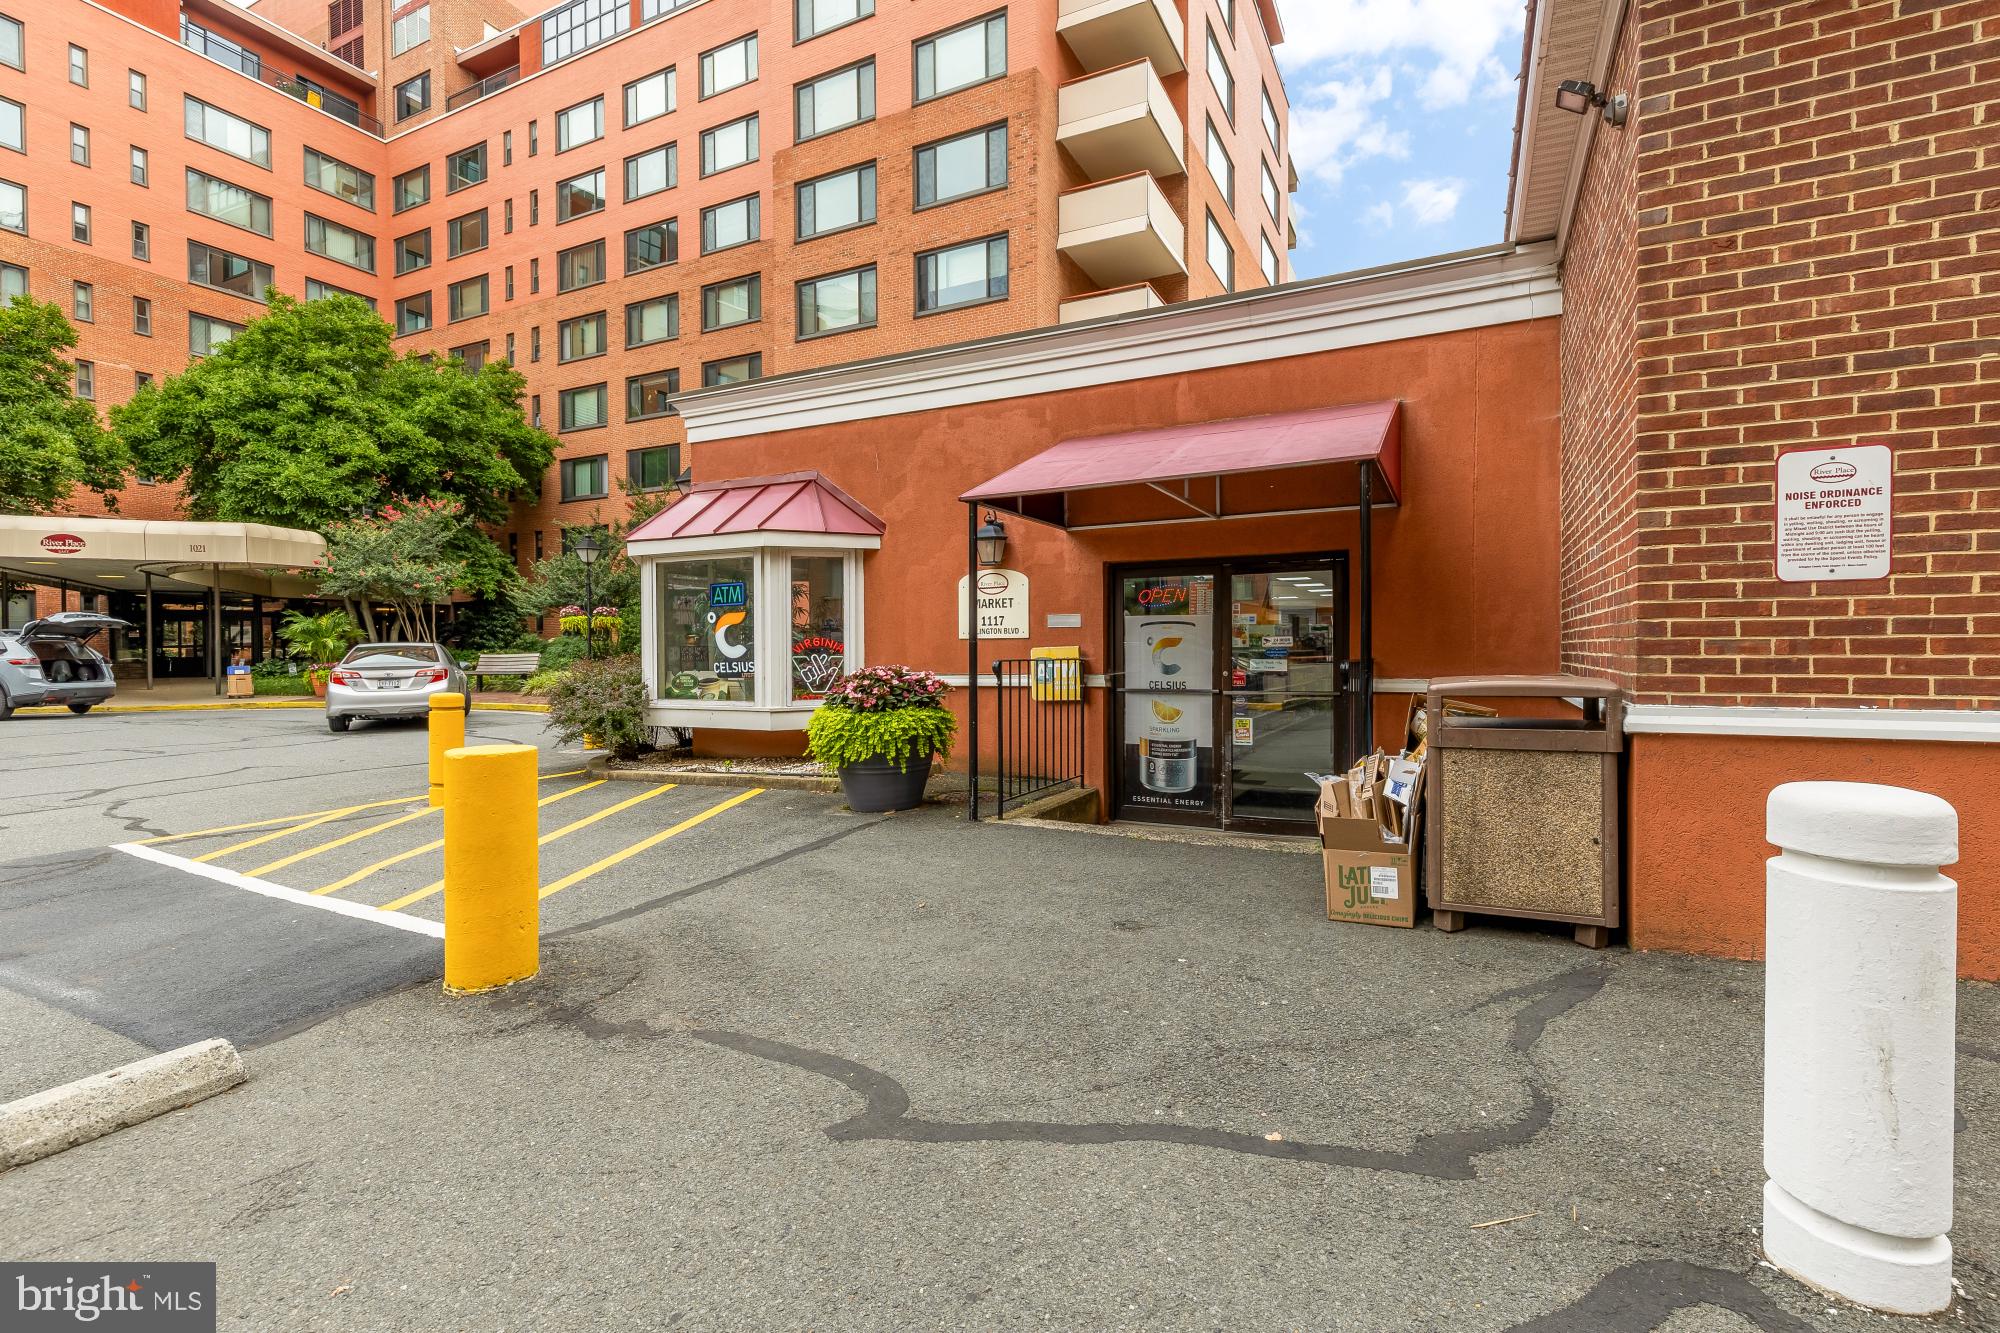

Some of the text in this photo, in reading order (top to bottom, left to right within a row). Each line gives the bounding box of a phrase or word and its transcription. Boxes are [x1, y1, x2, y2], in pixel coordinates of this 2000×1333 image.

[1785, 486, 1883, 500] NOISE ORDINANCE
[1805, 498, 1862, 510] ENFORCED
[66, 538, 85, 547] Place
[189, 544, 206, 552] 1021
[714, 586, 742, 604] ATM
[1138, 588, 1187, 604] OPEN
[982, 616, 1004, 626] 1117
[792, 637, 844, 654] VIRGINIA
[714, 662, 754, 673] CELSIUS
[1149, 680, 1187, 690] CELSIUS
[1132, 796, 1204, 806] ESSENTIAL ENERGY
